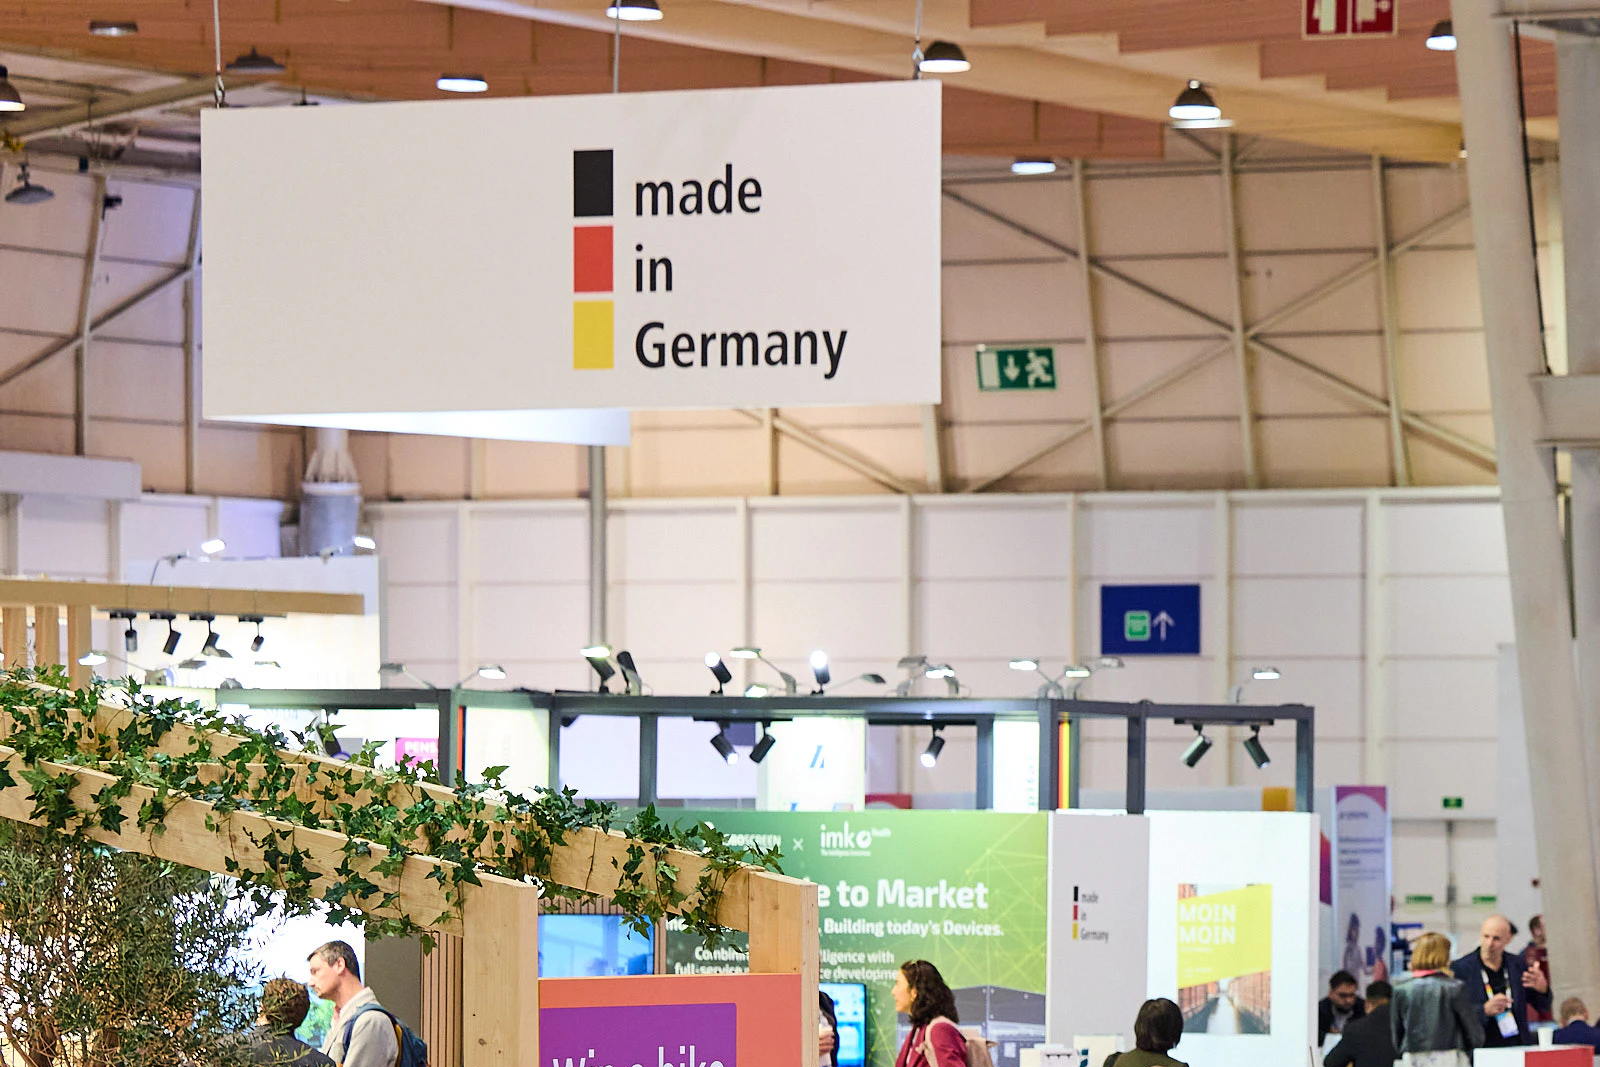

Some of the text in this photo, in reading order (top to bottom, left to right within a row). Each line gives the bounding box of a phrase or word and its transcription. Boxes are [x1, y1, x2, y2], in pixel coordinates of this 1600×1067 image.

[636, 163, 762, 216] made
[636, 244, 672, 292] in
[636, 322, 848, 379] Germany
[837, 880, 869, 908] to
[877, 879, 988, 909] Market
[1081, 891, 1099, 904] made
[1179, 904, 1236, 923] MOIN
[824, 917, 1005, 938] Building today's Devices.
[1081, 928, 1109, 943] Germany
[1179, 925, 1236, 944] MOIN
[820, 949, 895, 966] lligence with
